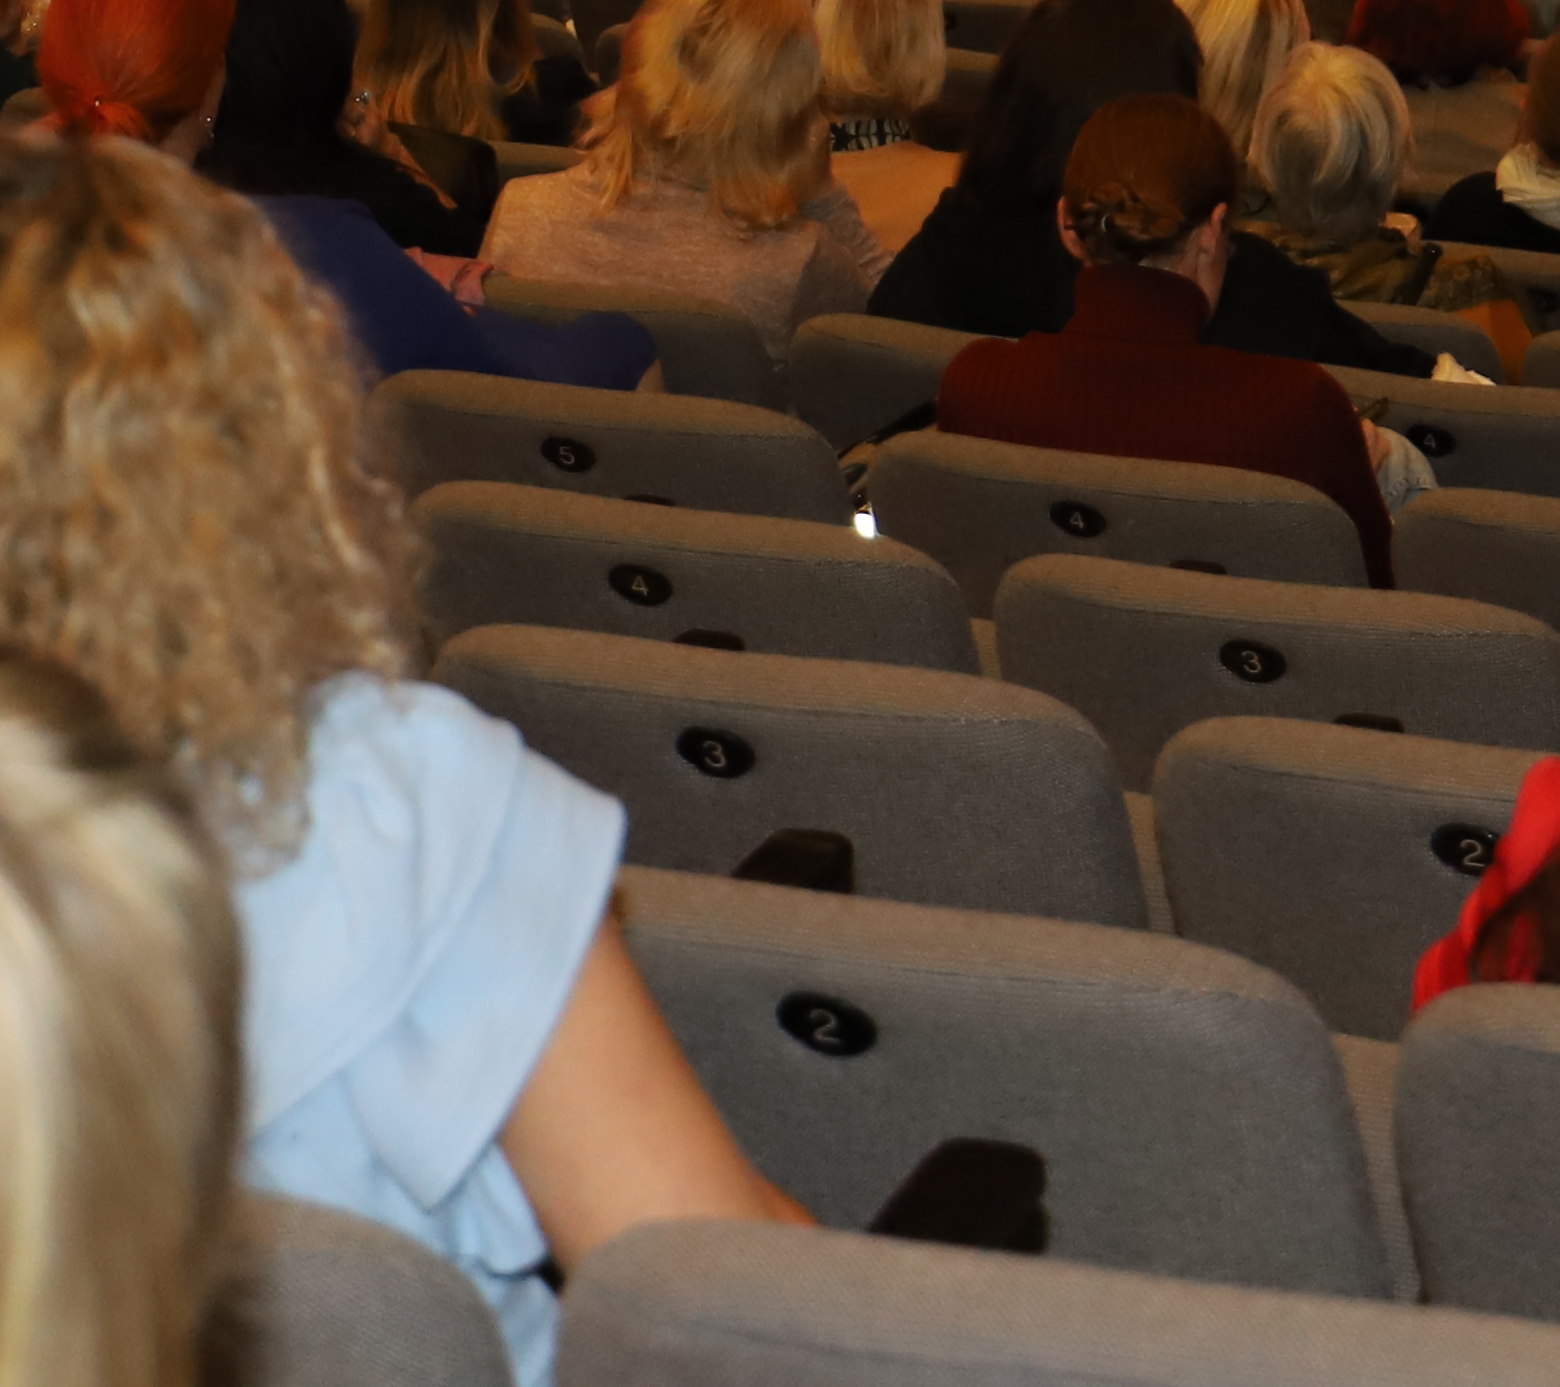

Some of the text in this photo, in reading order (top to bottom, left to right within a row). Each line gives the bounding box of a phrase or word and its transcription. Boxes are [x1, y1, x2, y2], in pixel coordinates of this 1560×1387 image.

[1423, 433, 1437, 450] 4
[558, 445, 576, 466] 5
[1068, 510, 1085, 530] 4
[630, 574, 650, 597] 4
[1241, 650, 1263, 674] 3
[702, 739, 727, 769] 3
[1459, 838, 1486, 867] 2
[809, 1007, 843, 1045] 2
